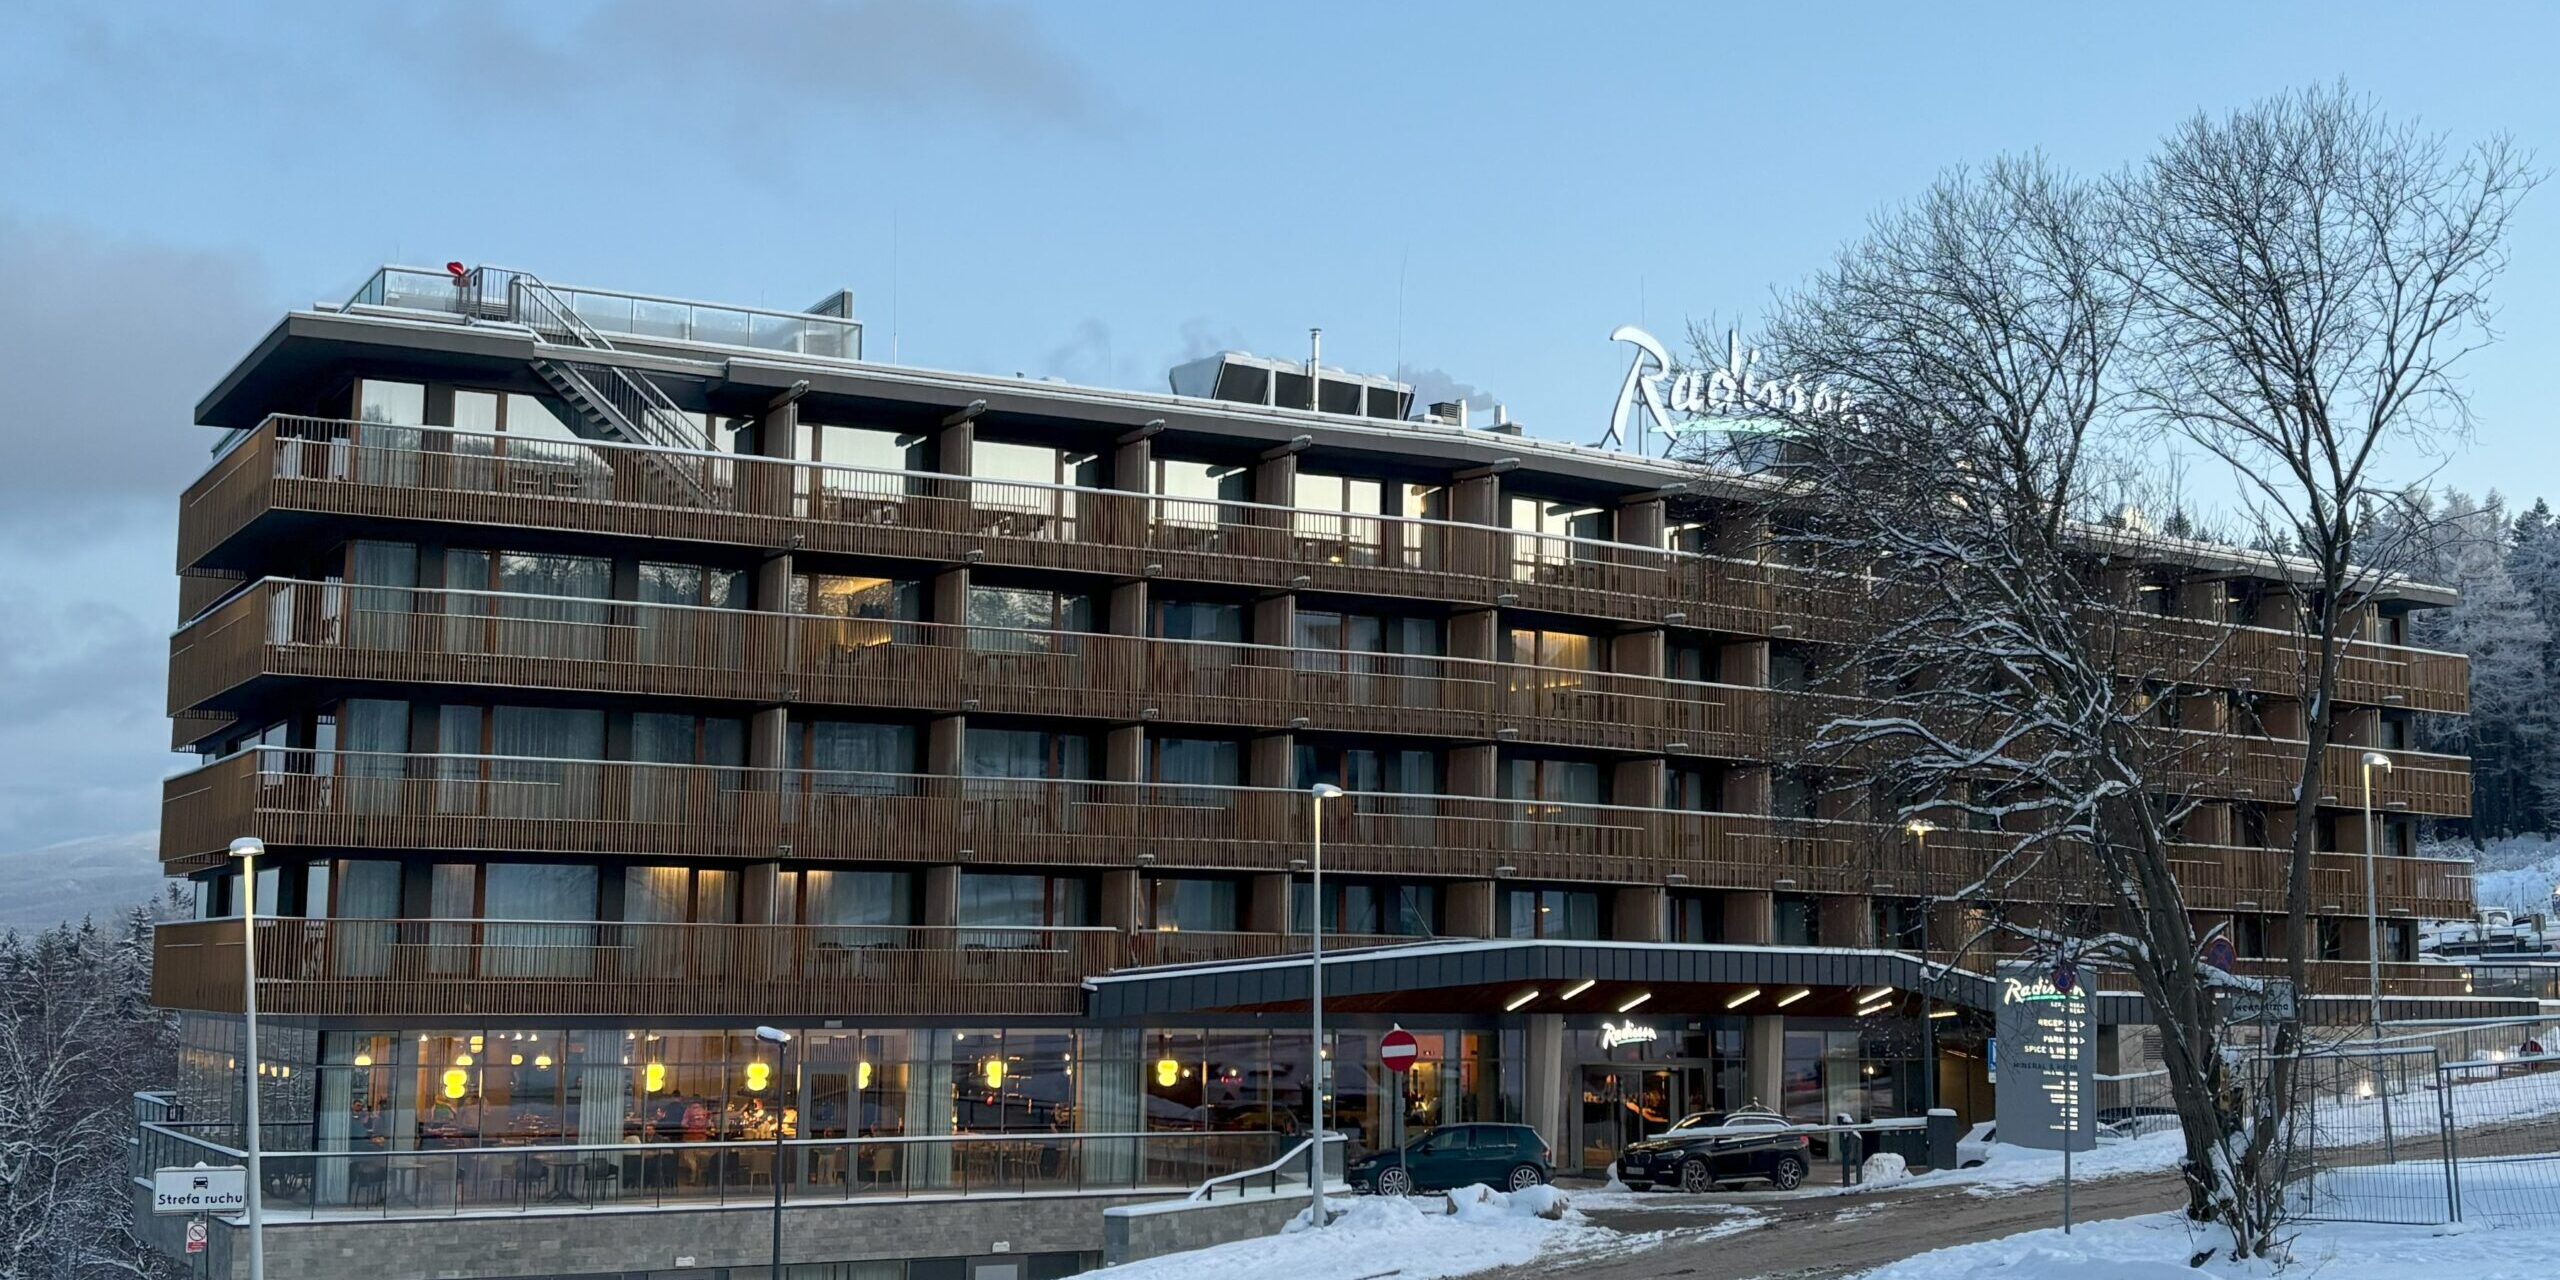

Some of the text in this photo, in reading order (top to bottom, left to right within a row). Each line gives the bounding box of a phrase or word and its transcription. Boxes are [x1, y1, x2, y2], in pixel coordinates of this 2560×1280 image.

[1602, 1019, 1657, 1049] Radisson
[2024, 1045, 2047, 1053] SPICE
[158, 1193, 242, 1205] Strefa ruchu
